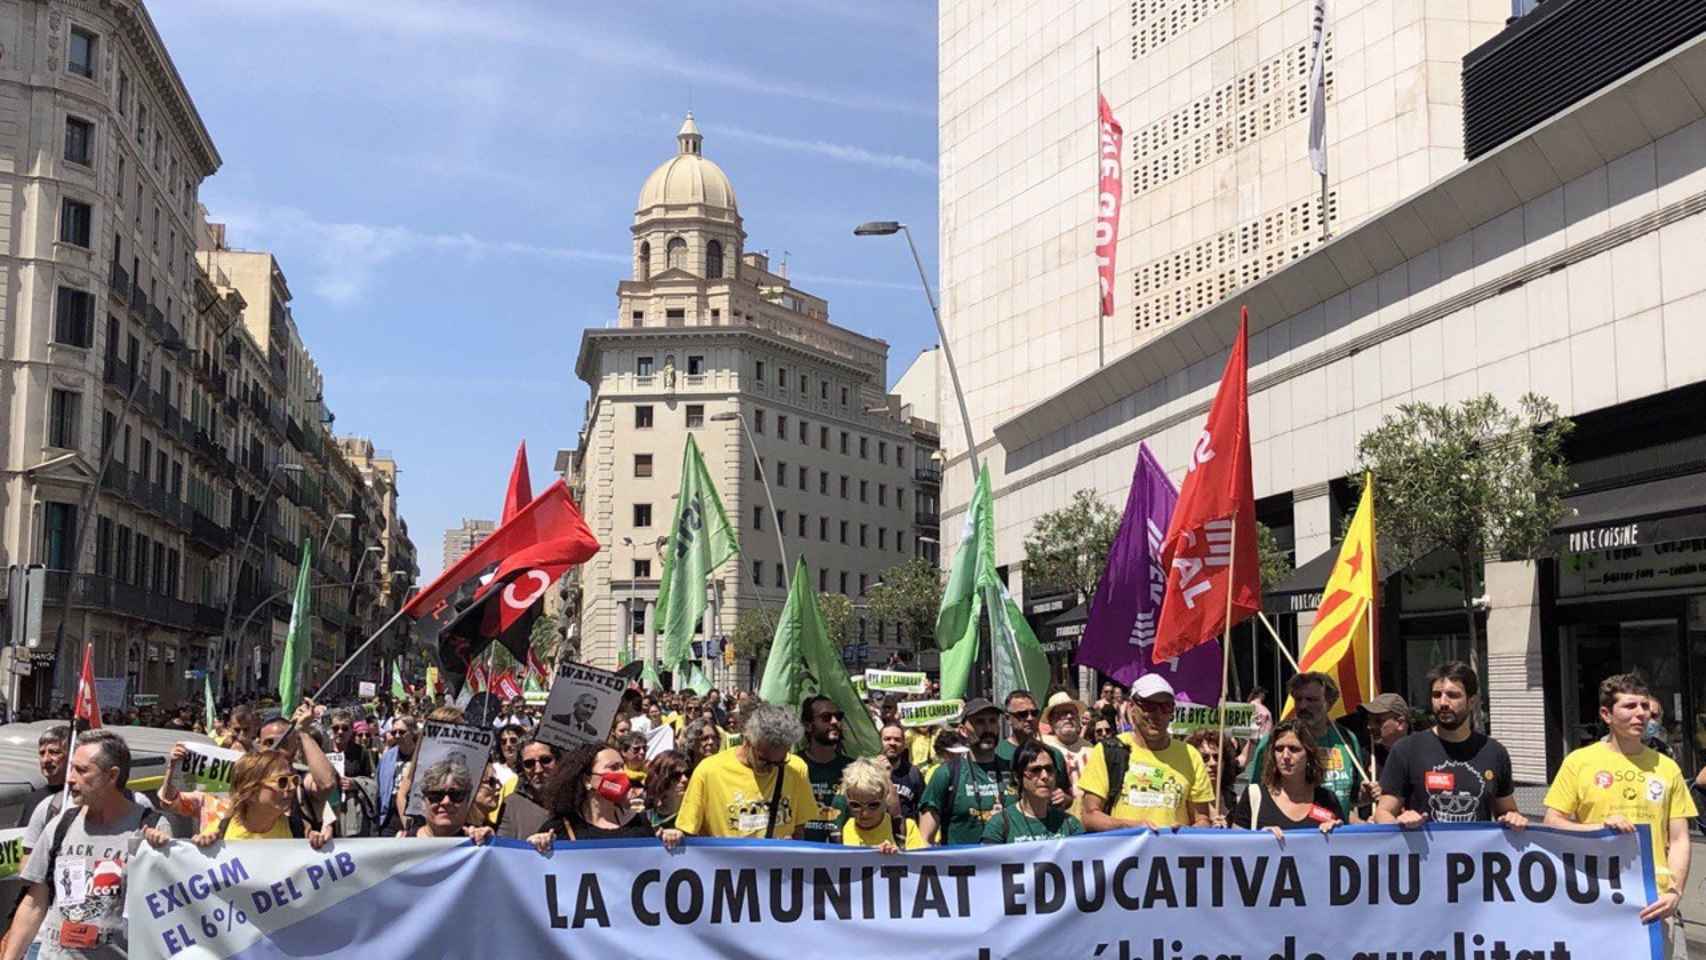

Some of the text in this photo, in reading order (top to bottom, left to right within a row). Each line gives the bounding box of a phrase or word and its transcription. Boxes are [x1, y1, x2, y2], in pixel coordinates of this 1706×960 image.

[1569, 529, 1597, 552] PURE
[561, 665, 625, 692] WANTED
[1189, 708, 1206, 724] BYE
[427, 725, 491, 745] WANTED
[182, 752, 208, 777] BYE
[1615, 770, 1646, 783] SOS
[93, 886, 120, 896] CGT
[145, 857, 250, 920] EXIGIM
[544, 851, 1625, 928] LA COMUNITAT EDUCATIVA DIU PROU!
[162, 851, 356, 955] EL 6% DEL PIB
